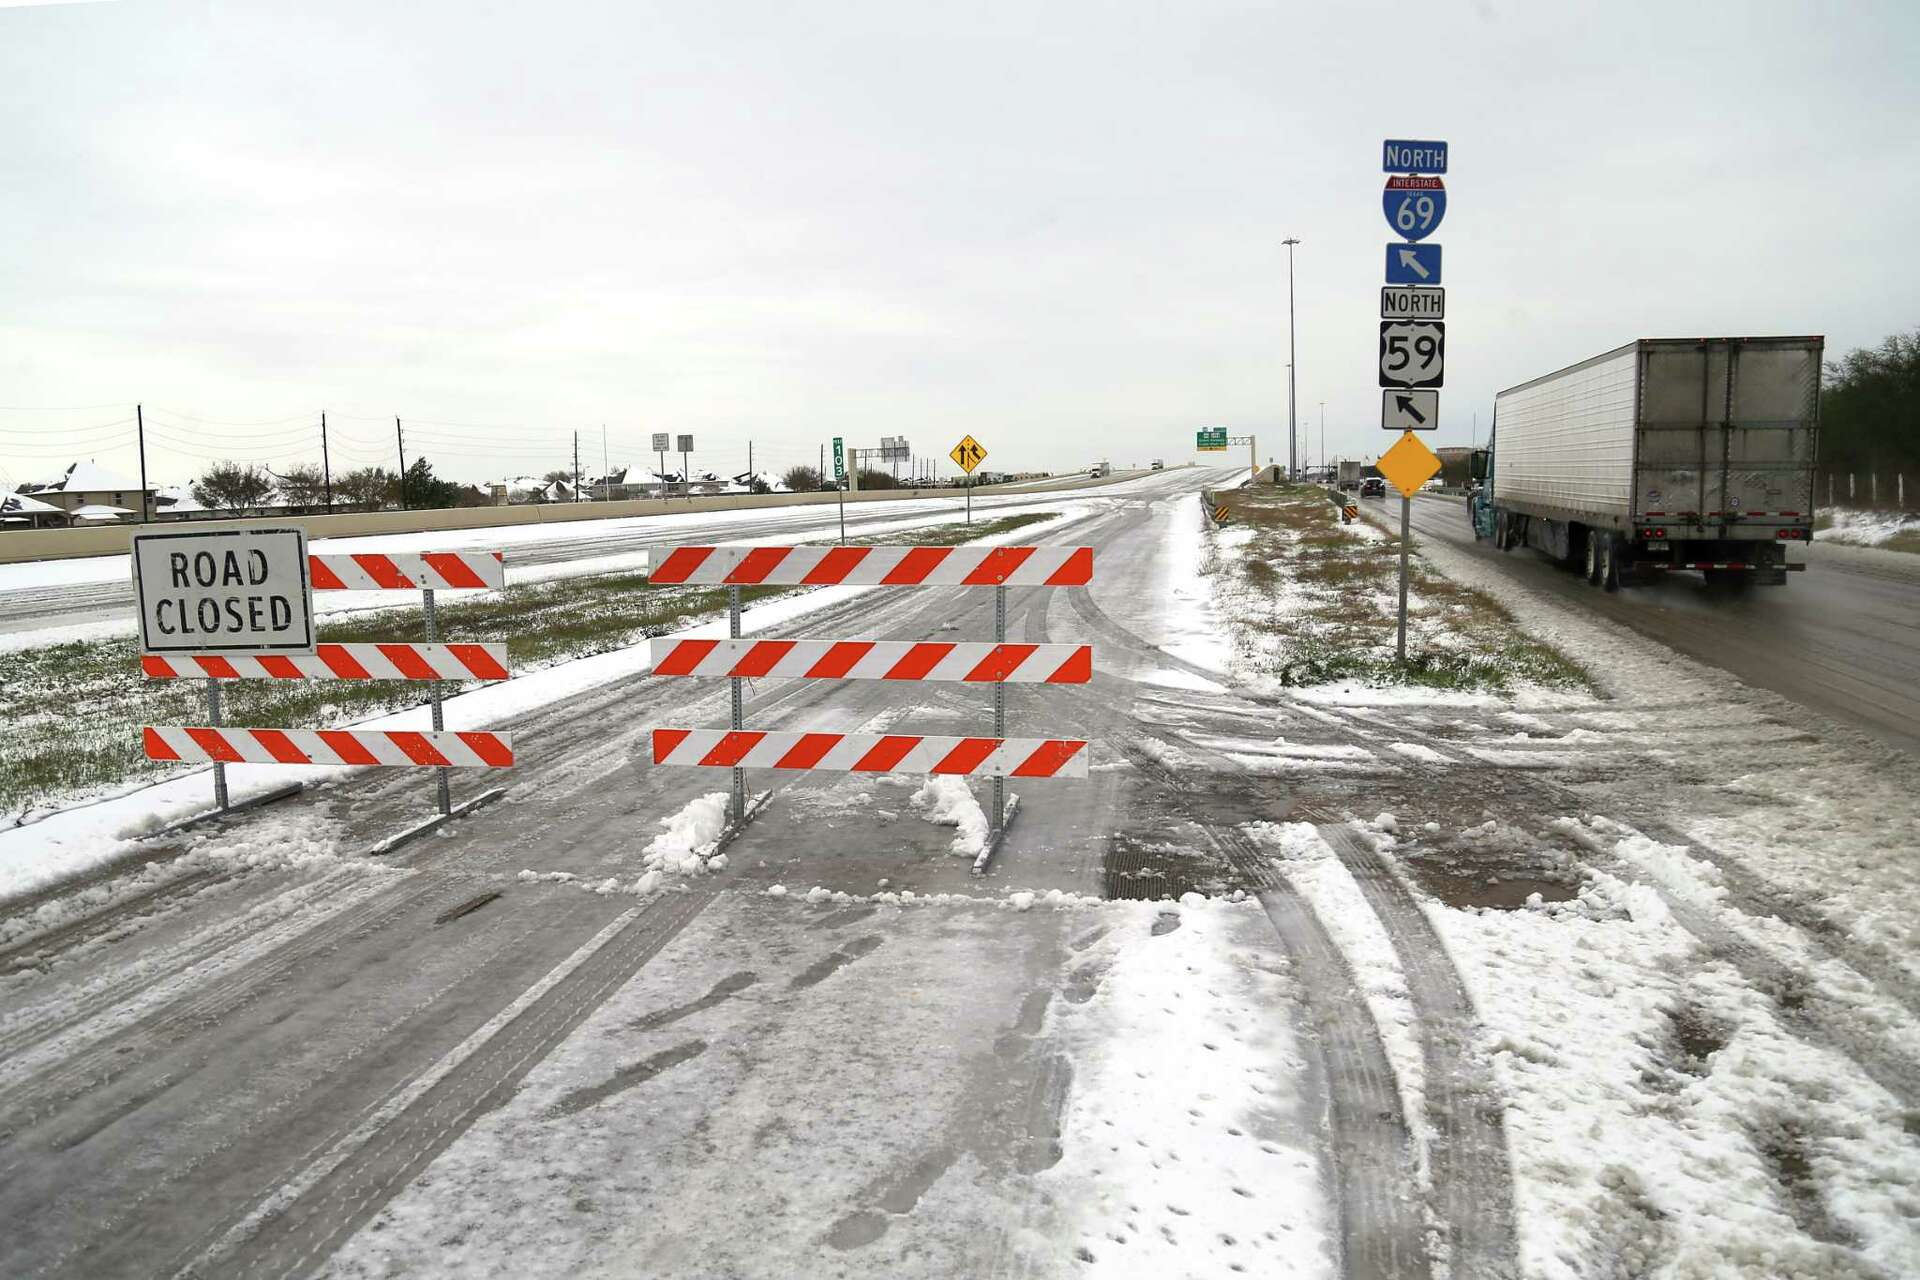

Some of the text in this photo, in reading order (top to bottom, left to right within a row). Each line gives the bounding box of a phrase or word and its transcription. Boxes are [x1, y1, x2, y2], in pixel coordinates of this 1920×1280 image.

[1386, 145, 1444, 168] NORTH
[1393, 179, 1439, 188] INTERSTATE
[1397, 196, 1434, 230] 69
[1384, 292, 1440, 312] NORTH
[1388, 335, 1436, 370] 59
[170, 549, 268, 588] ROAD
[156, 595, 292, 634] CLOSED
